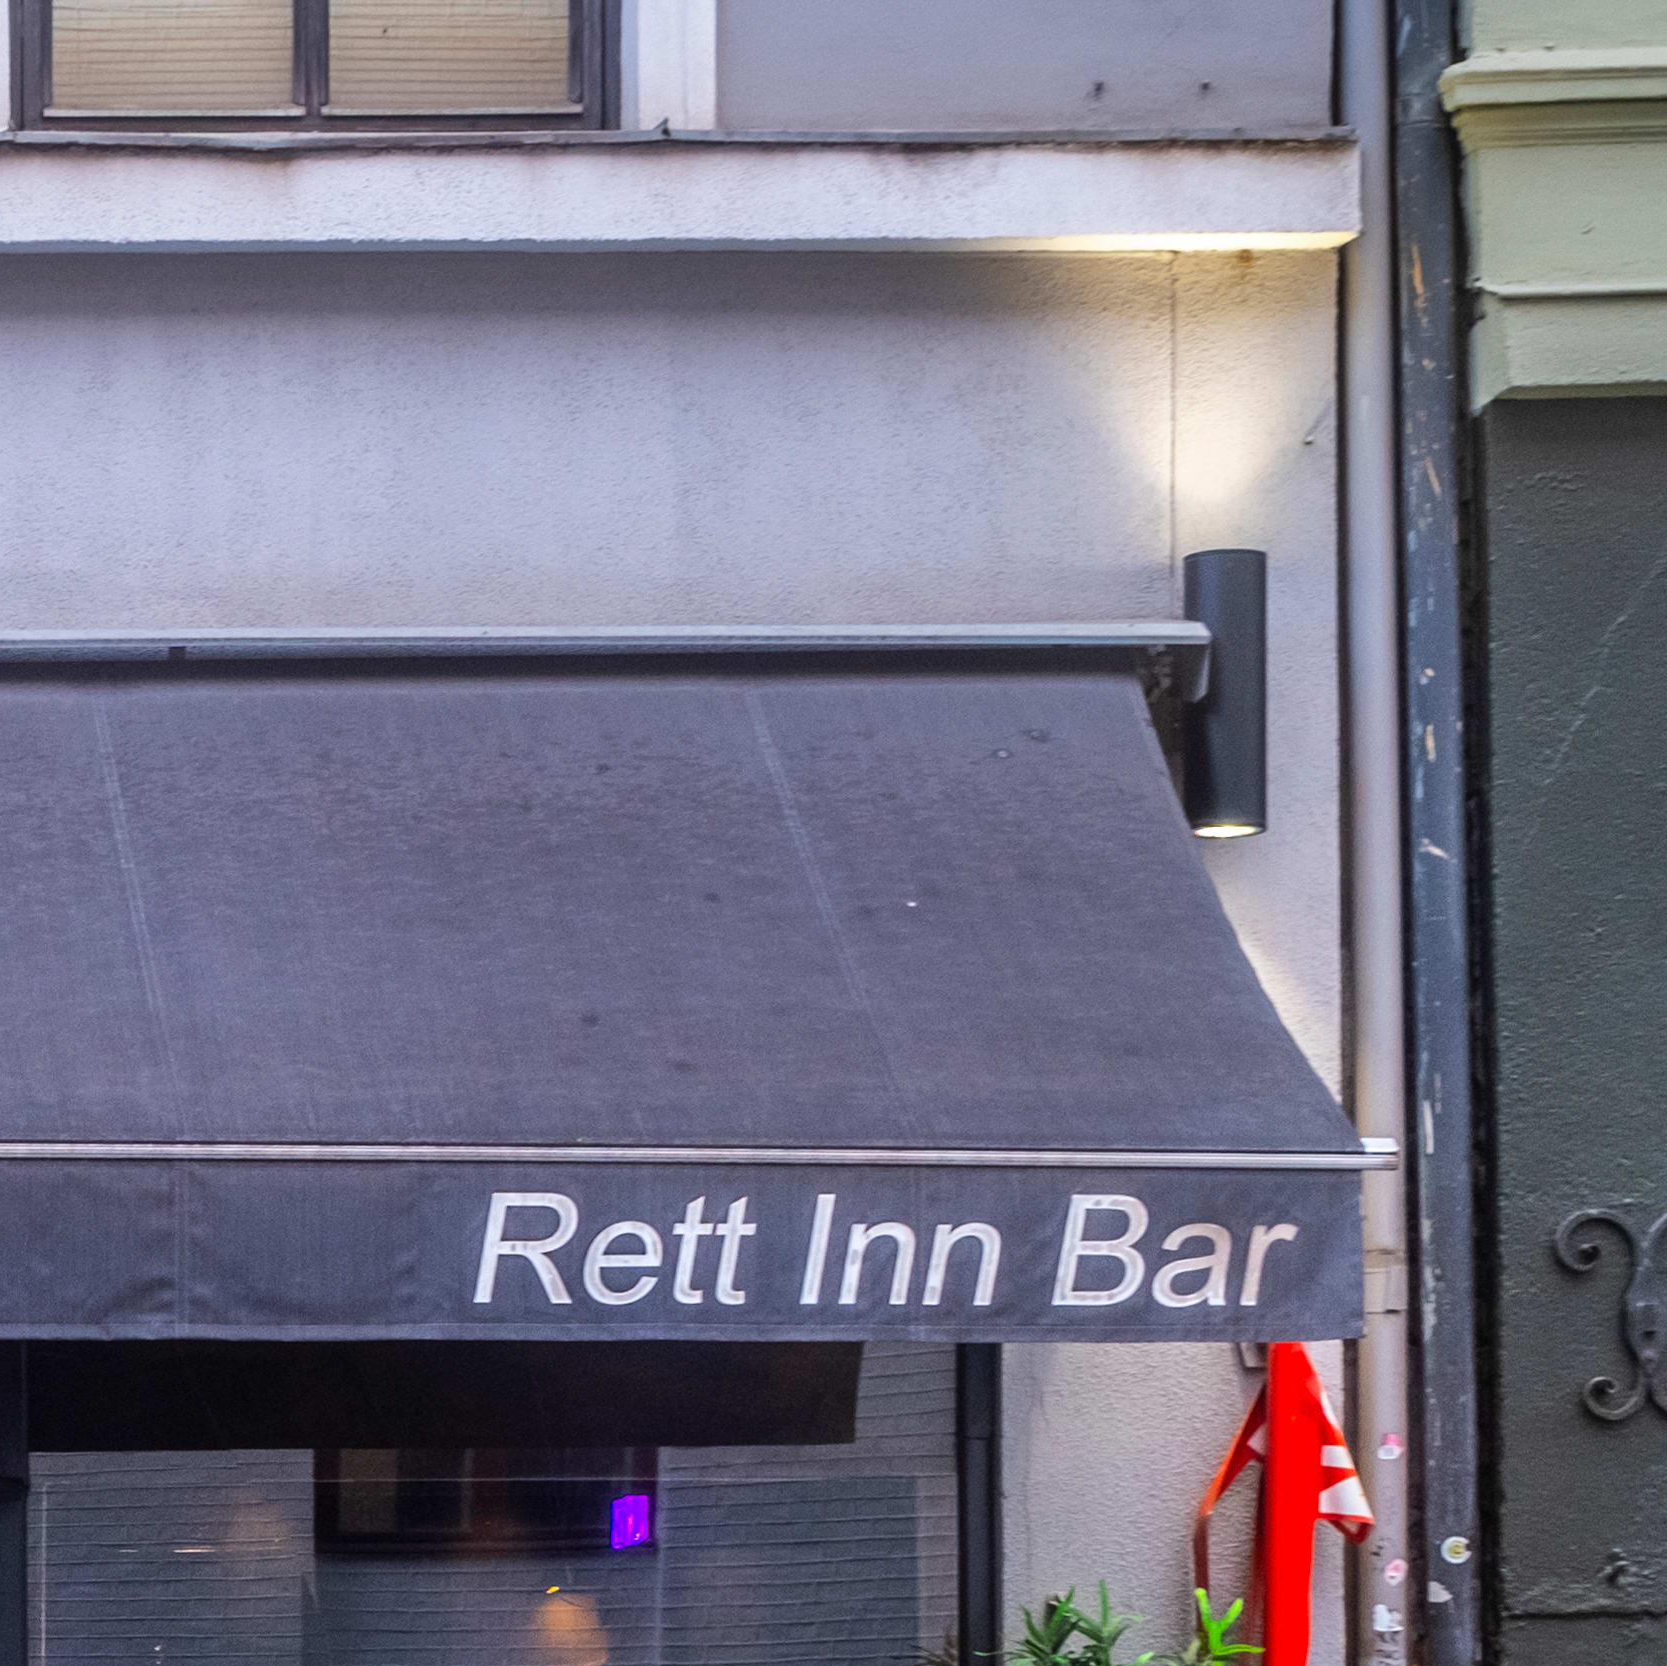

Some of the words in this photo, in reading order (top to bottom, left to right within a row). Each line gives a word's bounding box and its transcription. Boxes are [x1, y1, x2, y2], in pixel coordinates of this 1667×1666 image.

[474, 1193, 758, 1306] Rett
[800, 1194, 1002, 1306] Inn
[1051, 1194, 1299, 1308] Bar
